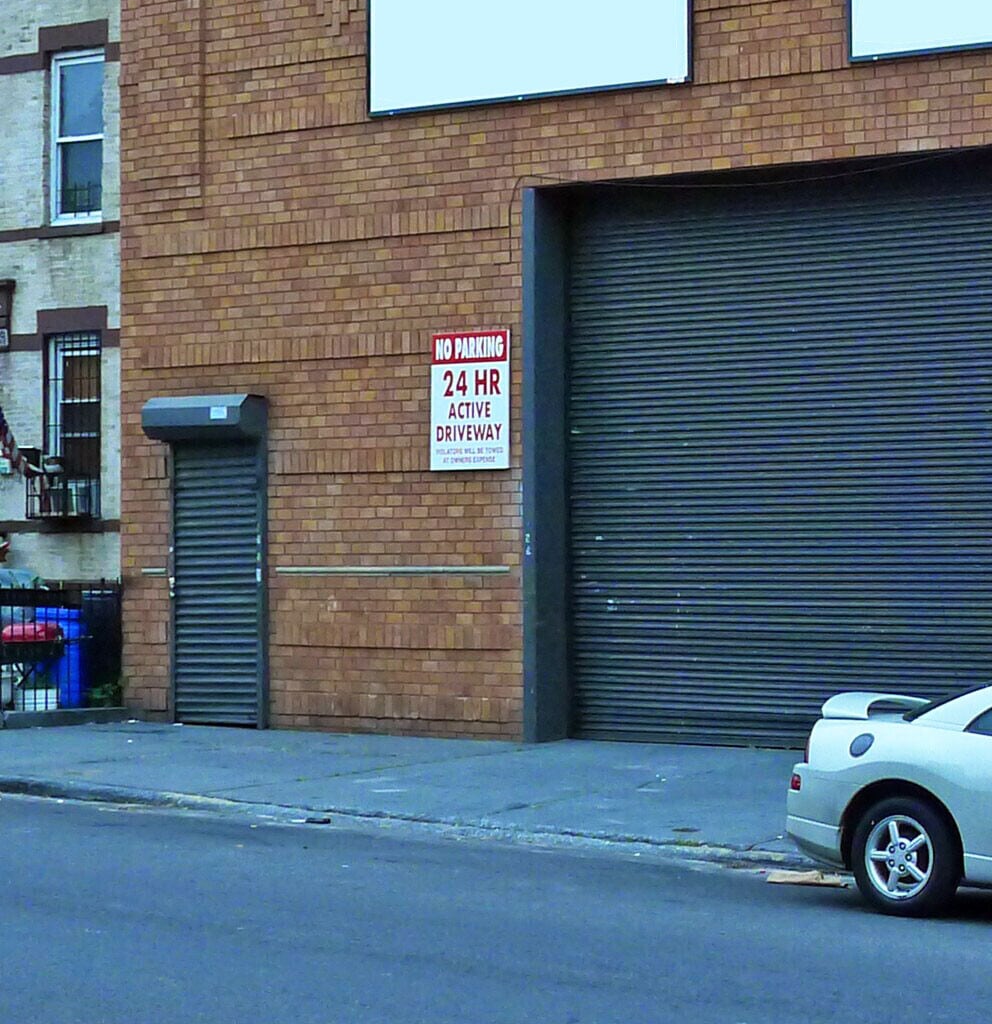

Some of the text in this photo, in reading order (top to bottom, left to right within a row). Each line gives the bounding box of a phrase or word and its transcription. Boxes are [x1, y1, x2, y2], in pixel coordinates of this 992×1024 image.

[435, 336, 504, 360] NO PARKING
[443, 369, 501, 397] 24 HR
[448, 402, 491, 419] ACTIVE
[436, 424, 502, 442] DRIVEWAY
